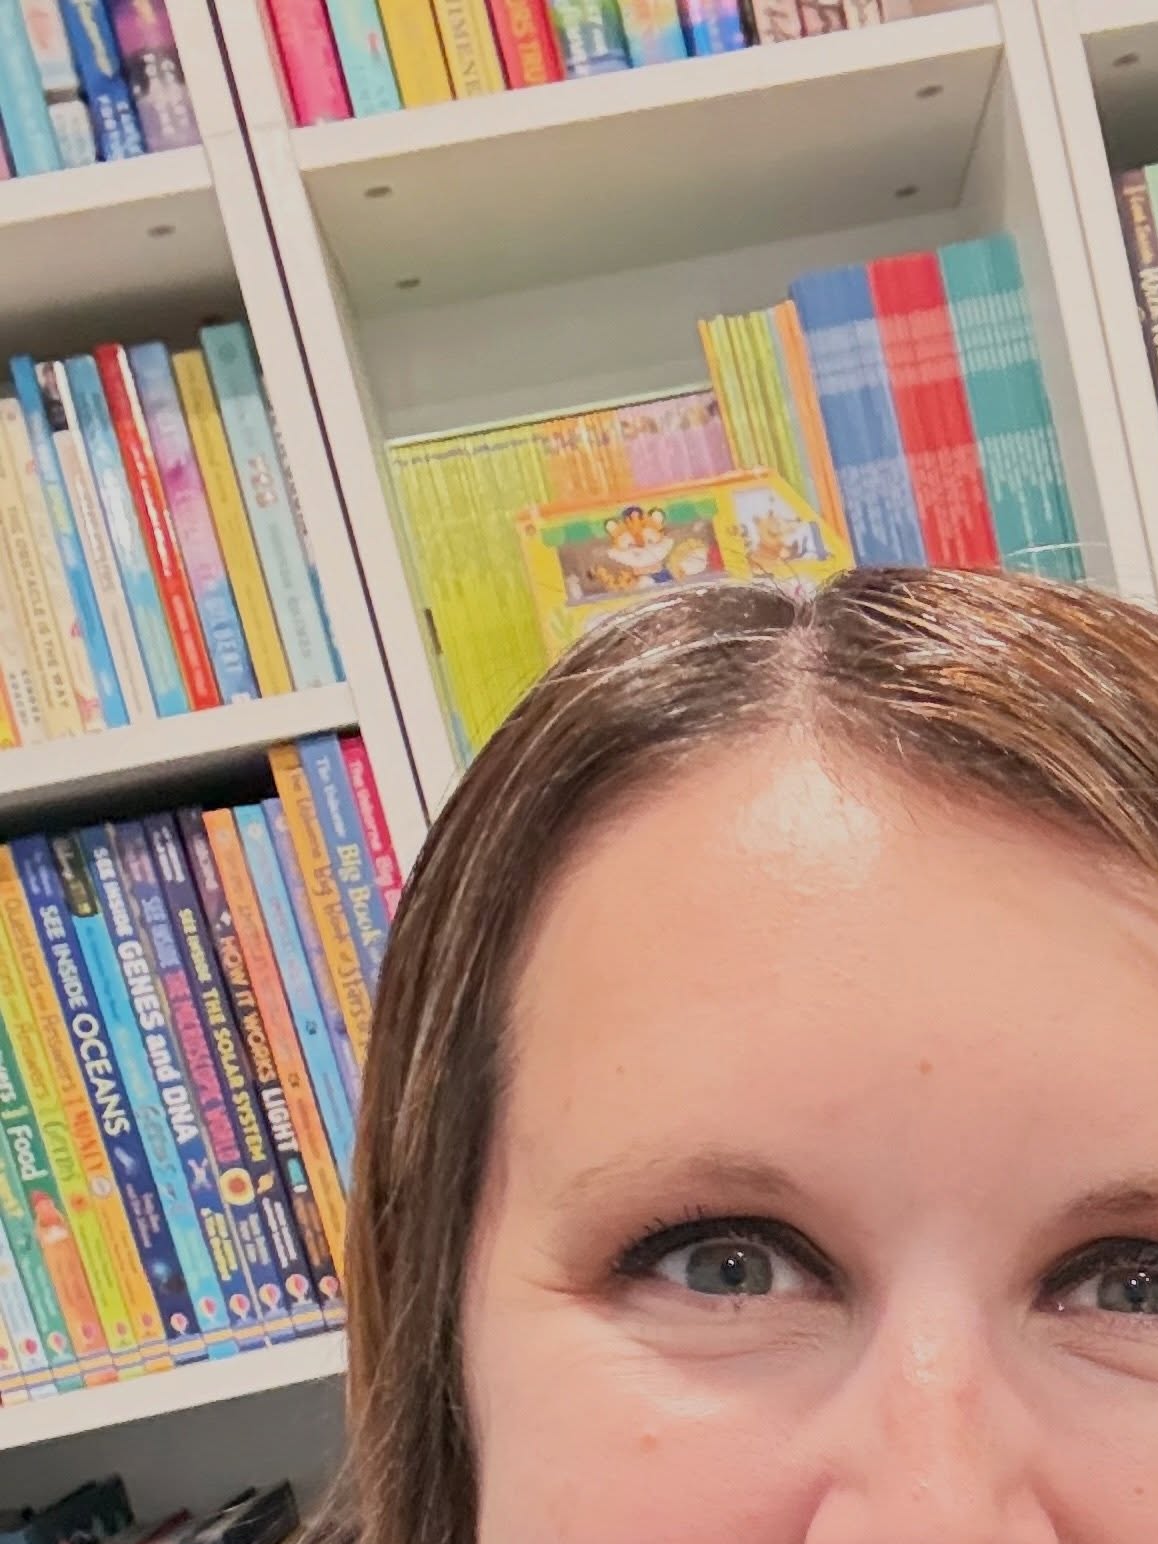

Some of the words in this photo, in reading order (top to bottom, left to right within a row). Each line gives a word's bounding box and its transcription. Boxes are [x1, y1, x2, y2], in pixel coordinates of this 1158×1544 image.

[92, 846, 115, 881] SEE
[331, 841, 367, 883] Big
[39, 903, 65, 941] SEE
[103, 880, 132, 937] INSIDE
[346, 884, 383, 946] Book
[52, 941, 88, 1010] INSIDE
[116, 938, 165, 1032] GENES
[218, 934, 247, 988] HOW
[201, 987, 226, 1026] THE
[234, 988, 253, 1010] IT
[69, 1010, 130, 1139] OCEANS
[144, 1030, 180, 1084] and
[212, 1026, 245, 1091] SOLAR
[240, 1012, 275, 1084] WORKS
[161, 1083, 199, 1145] DNA
[232, 1091, 266, 1163] SYSTEM
[260, 1085, 298, 1154] LIGHT
[5, 1121, 49, 1183] Food
